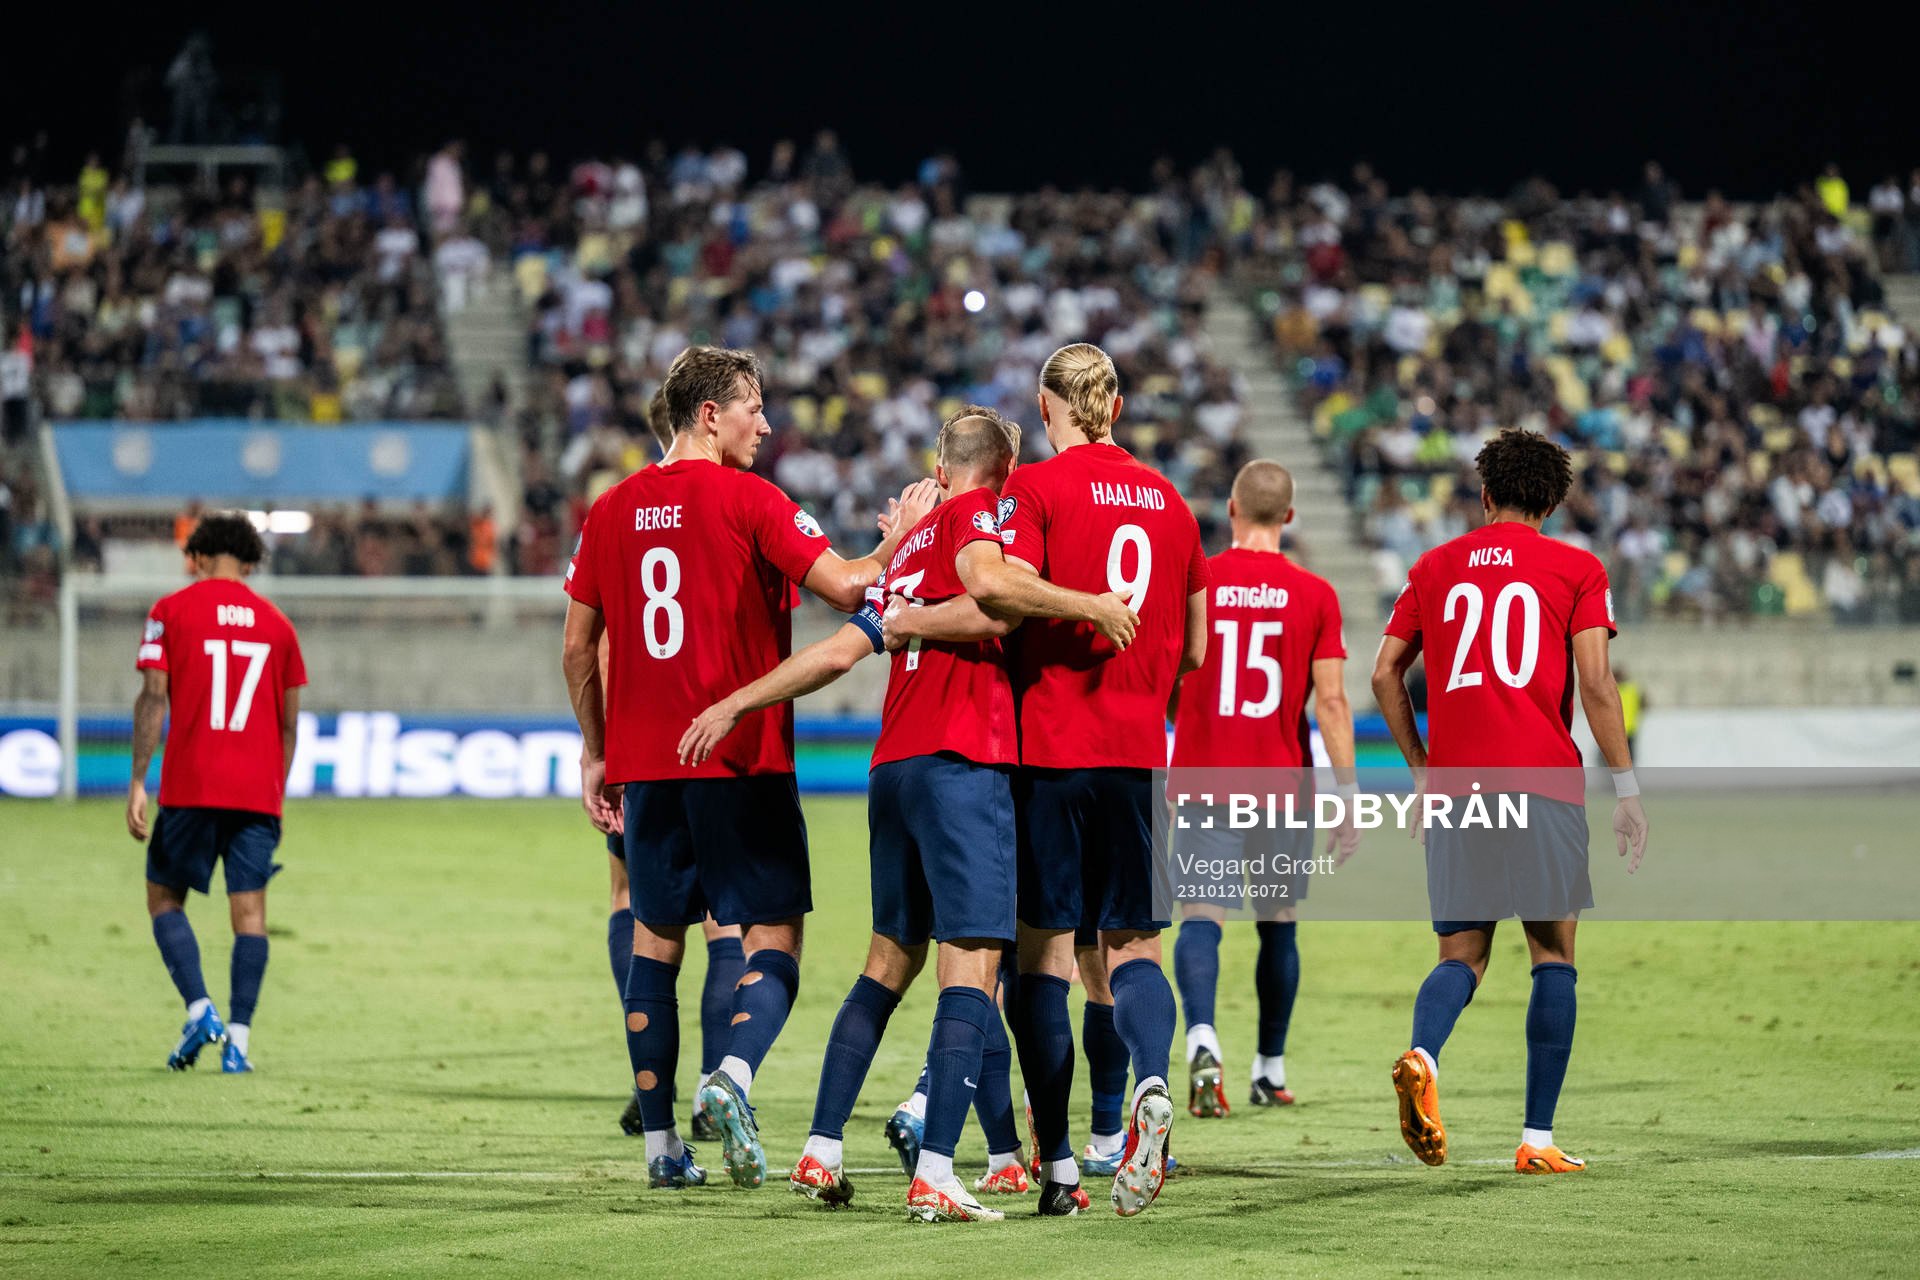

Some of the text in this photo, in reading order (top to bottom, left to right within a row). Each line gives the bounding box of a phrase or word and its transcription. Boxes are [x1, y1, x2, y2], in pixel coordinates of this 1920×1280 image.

[635, 505, 682, 531] BERGE
[1091, 482, 1165, 511] HAALAND
[1106, 523, 1152, 615] 9
[1468, 547, 1514, 568] NUSA
[217, 604, 255, 628] BOBB
[641, 547, 685, 660] 8
[868, 612, 883, 630] RES
[1215, 583, 1289, 609] ØSTIGÅRD
[1443, 581, 1541, 694] 20
[204, 639, 271, 732] 17
[1214, 619, 1284, 719] 15
[0, 711, 582, 798] e Hisen
